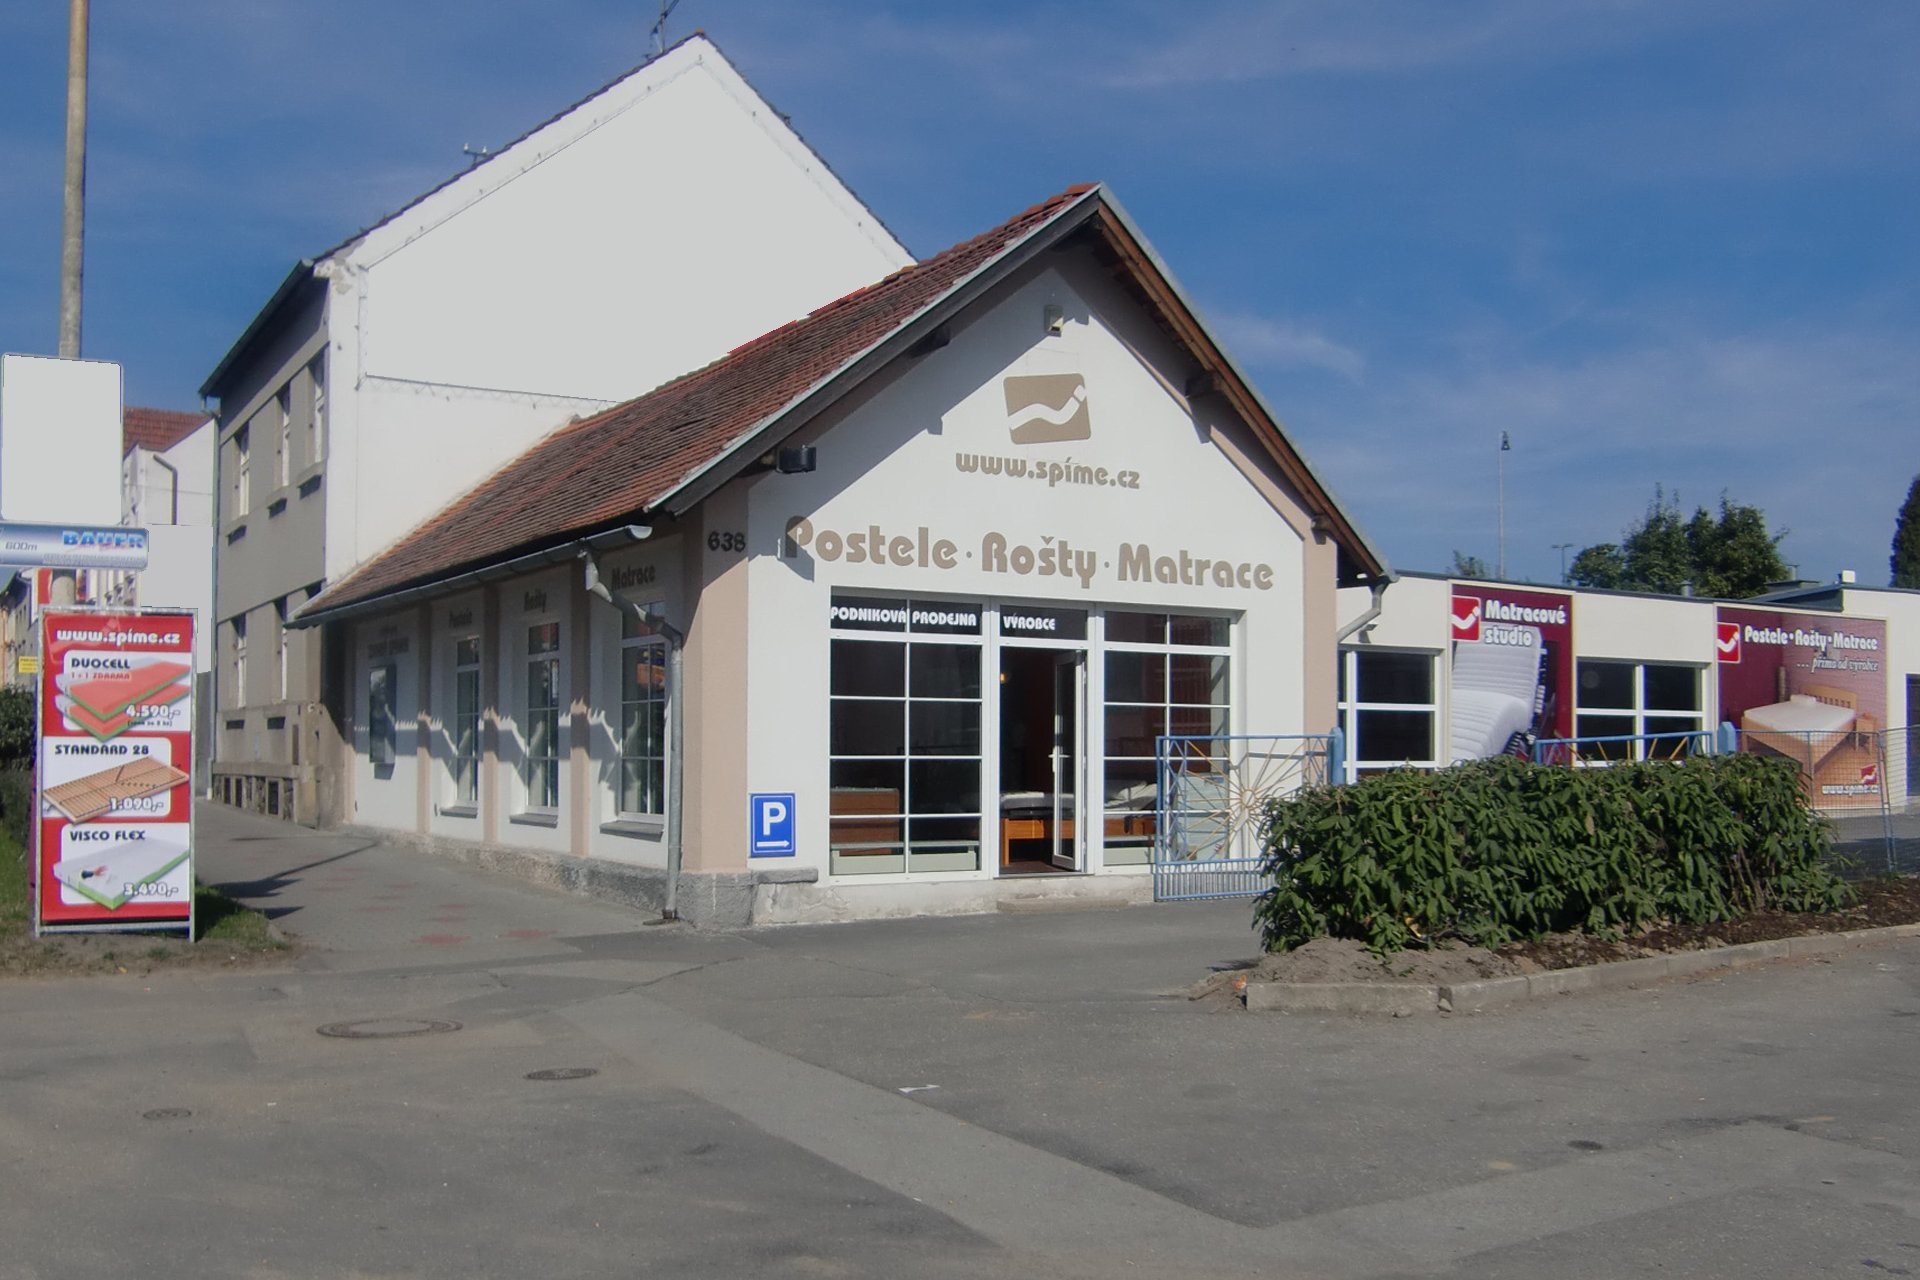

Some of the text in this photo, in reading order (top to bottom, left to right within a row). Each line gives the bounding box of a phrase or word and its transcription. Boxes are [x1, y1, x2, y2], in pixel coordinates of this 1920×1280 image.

[955, 452, 1140, 490] www.spíme.cz
[5, 541, 38, 552] 600m
[62, 530, 145, 549] BAUER
[707, 531, 746, 553] 638
[784, 515, 1275, 590] Postele Rošty Matrace
[830, 606, 1056, 631] PODNIKOVÁ PRODEJNA VÝROBCE
[1485, 599, 1567, 625] Matracové
[56, 628, 181, 647] www.spíme.cz
[1485, 625, 1533, 647] studio
[1744, 625, 1879, 651] Postele Rošty Matrace
[71, 658, 131, 669] DUOCELL
[55, 744, 150, 755] STANDARD 28
[763, 801, 787, 836] P
[70, 830, 146, 842] VISCO FLEX
